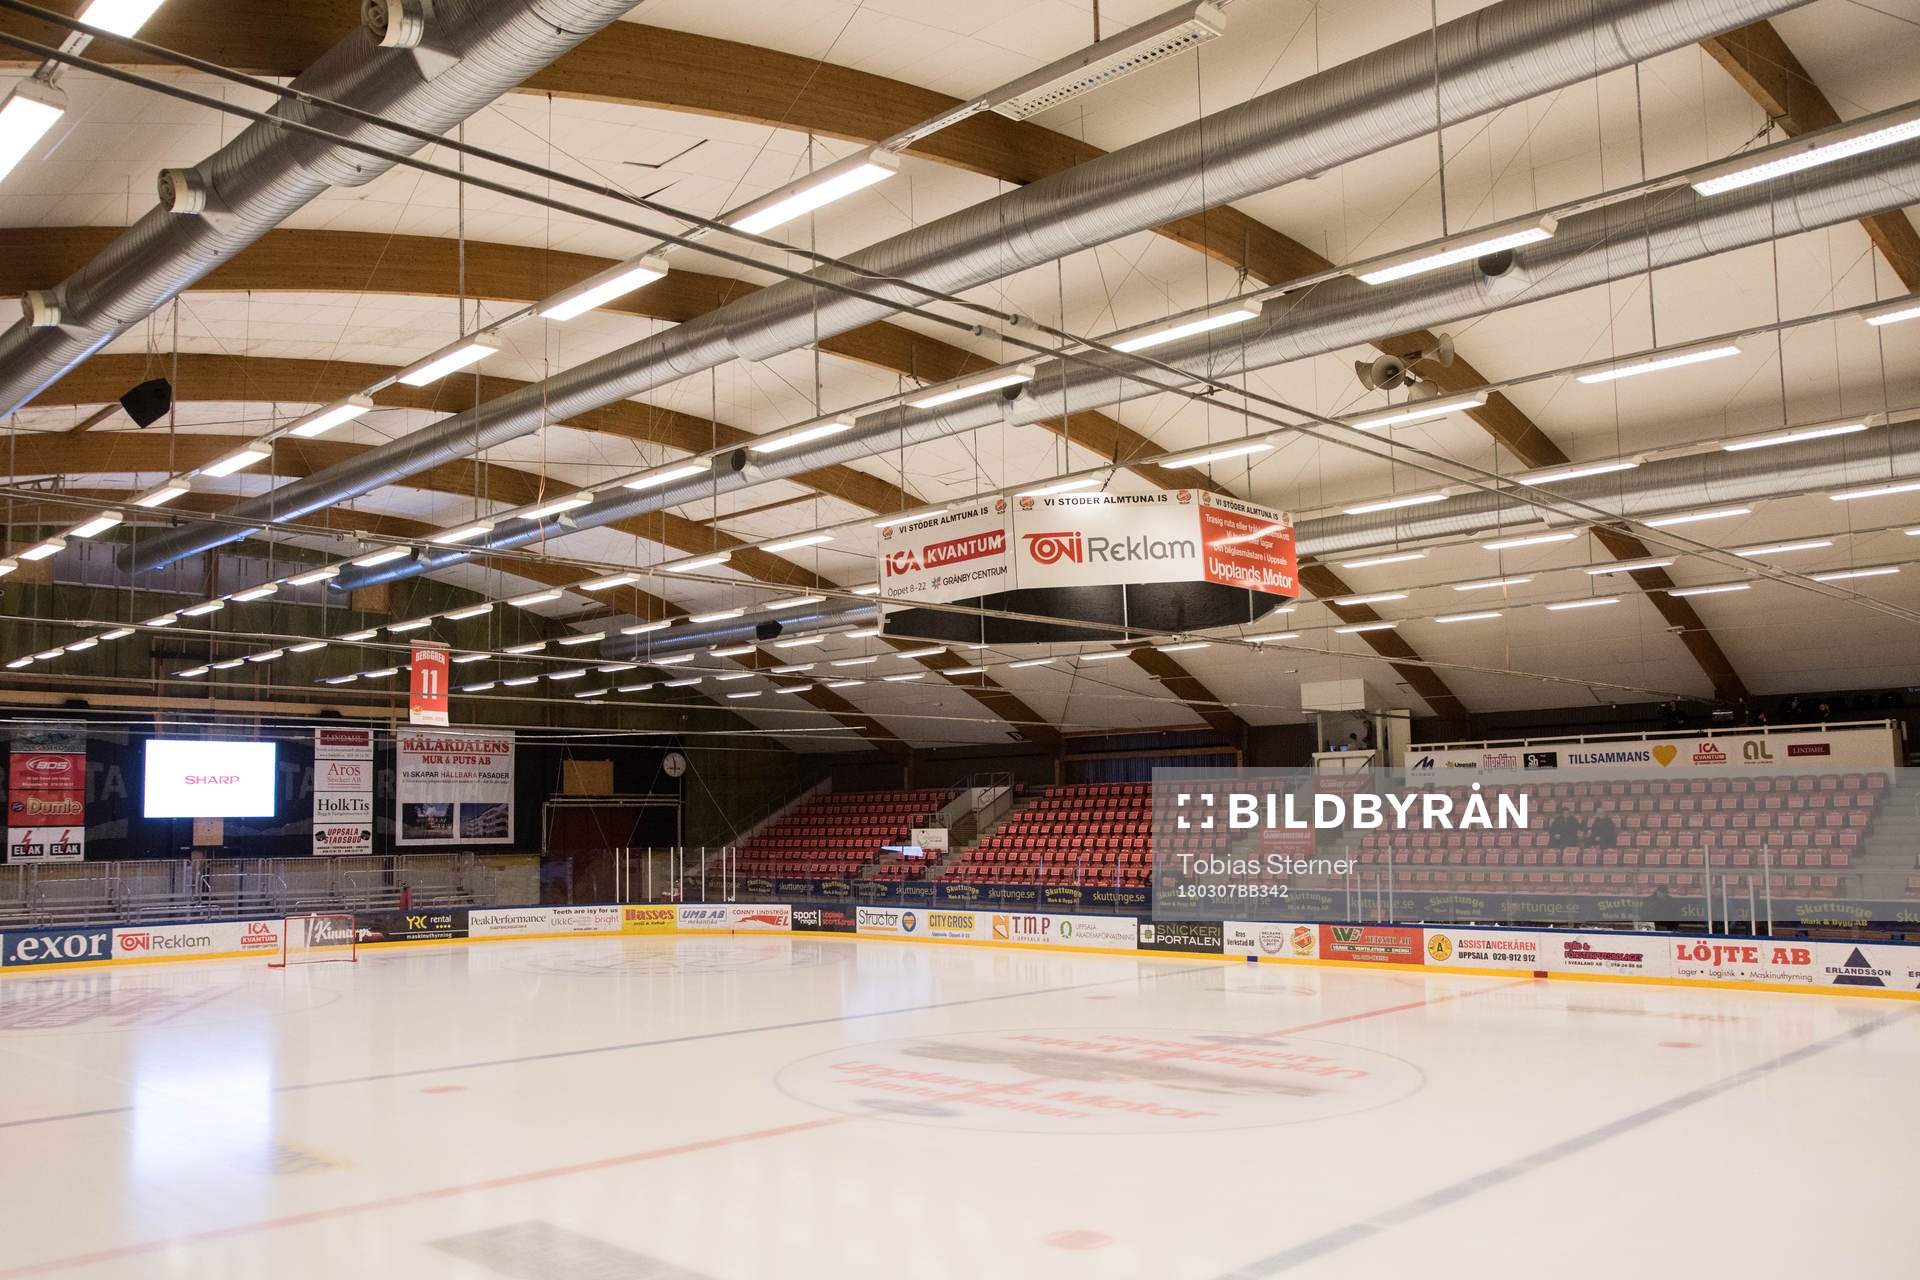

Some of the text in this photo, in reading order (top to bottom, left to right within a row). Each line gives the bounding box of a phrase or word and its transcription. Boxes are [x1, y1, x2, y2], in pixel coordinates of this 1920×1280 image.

[1044, 494, 1168, 506] VI STÖDER ALMTUNA IS
[1215, 498, 1279, 520] VI STÖDER ALMTUNA IS
[899, 506, 989, 534] VI STÖDER ALMTUNA IS
[1205, 514, 1224, 527] Trasig
[1087, 535, 1196, 563] Reklam
[885, 535, 1002, 577] ICA KVANTUM
[971, 565, 1008, 580] CENTRUM
[1209, 556, 1293, 588] Upplands Motor
[421, 669, 438, 699] 11
[402, 734, 510, 753] MÄLARDALENS
[1698, 742, 1719, 754] ICA
[422, 755, 443, 765] MUR
[452, 755, 477, 765] PUTS
[478, 756, 491, 766] AB
[1568, 750, 1651, 765] TILLSAMMANS
[327, 763, 361, 776] Aros
[478, 772, 510, 780] FASADER
[184, 775, 241, 785] SHARP
[26, 797, 83, 816] Dumle
[327, 827, 359, 837] UPPSALA
[324, 835, 362, 845] STADSBUD
[988, 888, 1035, 900] skuttunge.se
[1045, 887, 1082, 899] Skuttunge
[1092, 891, 1145, 903] skuttunge.se
[1351, 898, 1414, 910] kuttunge.se
[1429, 895, 1485, 908] Skuttunge
[682, 910, 725, 919] UMB AB
[793, 910, 817, 920] sport
[859, 909, 898, 926] Structor
[1795, 903, 1872, 919] Skuttunge
[406, 915, 427, 929] YRC
[430, 915, 452, 923] rental
[776, 916, 789, 926] EL
[929, 914, 973, 928] CITY GROSS
[248, 923, 270, 934] ICA
[1157, 925, 1221, 936] SNICKERI
[9, 933, 107, 962] .exor
[153, 935, 211, 950] Reklam
[1157, 936, 1221, 946] PORTALEN
[1458, 940, 1536, 951] ASSISTANCEKÅREN
[1458, 952, 1536, 962] UPPSALA 020-912 912
[1677, 940, 1812, 966] LÖJTE AB
[1678, 968, 1813, 982] Lager Logistik Maskinuthyrning
[1826, 966, 1891, 976] ERLANDSSON
[1044, 1091, 1217, 1119] Motor
